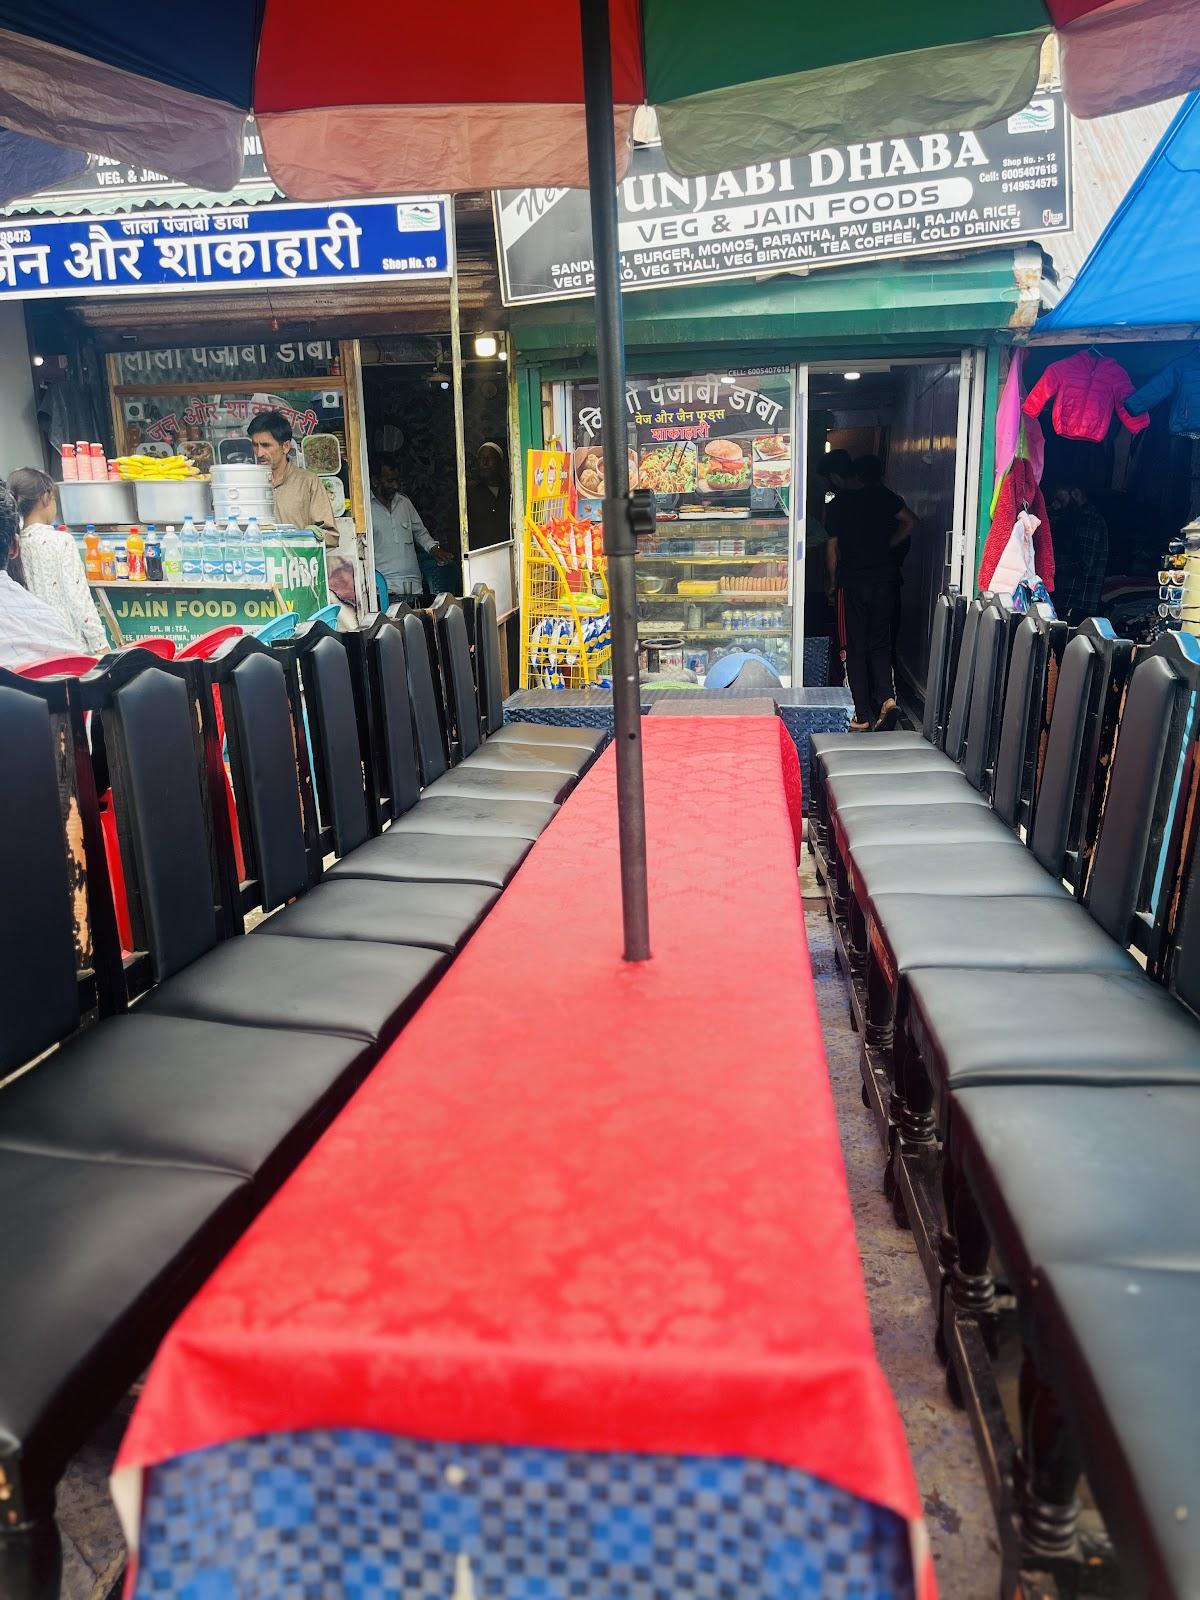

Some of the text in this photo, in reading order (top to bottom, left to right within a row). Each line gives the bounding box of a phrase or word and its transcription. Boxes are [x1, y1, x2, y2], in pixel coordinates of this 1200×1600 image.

[616, 131, 989, 213] UNJABI DHABA
[1003, 158, 1021, 168] Shop
[1024, 156, 1036, 165] No.
[1046, 153, 1056, 162] 12
[97, 171, 124, 186] VEG.
[127, 170, 138, 183] &
[979, 164, 1058, 183] Cell: 6005407618
[1001, 176, 1058, 193] 9149634575
[516, 188, 561, 221] Ne
[637, 185, 939, 243] VEG & JAIN FOODS
[121, 220, 159, 236] लाला
[212, 213, 250, 230] डाबा
[634, 244, 695, 265] BURGER,
[698, 238, 759, 257] MOMOS,
[762, 227, 835, 248] PARATHA,
[839, 221, 868, 238] PAV
[872, 216, 920, 234] BHAJI,
[924, 208, 980, 228] RAJMA
[983, 204, 1021, 221] RICE,
[63, 225, 145, 281] और
[153, 212, 363, 278] शाकाहारी
[553, 275, 582, 289] VEG
[641, 266, 670, 278] VEG
[673, 257, 720, 273] THALI,
[724, 253, 753, 267] VEG
[756, 243, 817, 262] BIRYANI,
[820, 240, 850, 254] TEA
[854, 231, 916, 251] COFFEE,
[920, 226, 961, 242] COLD
[964, 217, 1021, 236] DRINKS
[382, 256, 437, 271] Shop No. 13
[655, 409, 675, 424] और
[729, 384, 784, 426] डाबा
[116, 600, 169, 618] JAIN
[175, 600, 237, 618] FOOD
